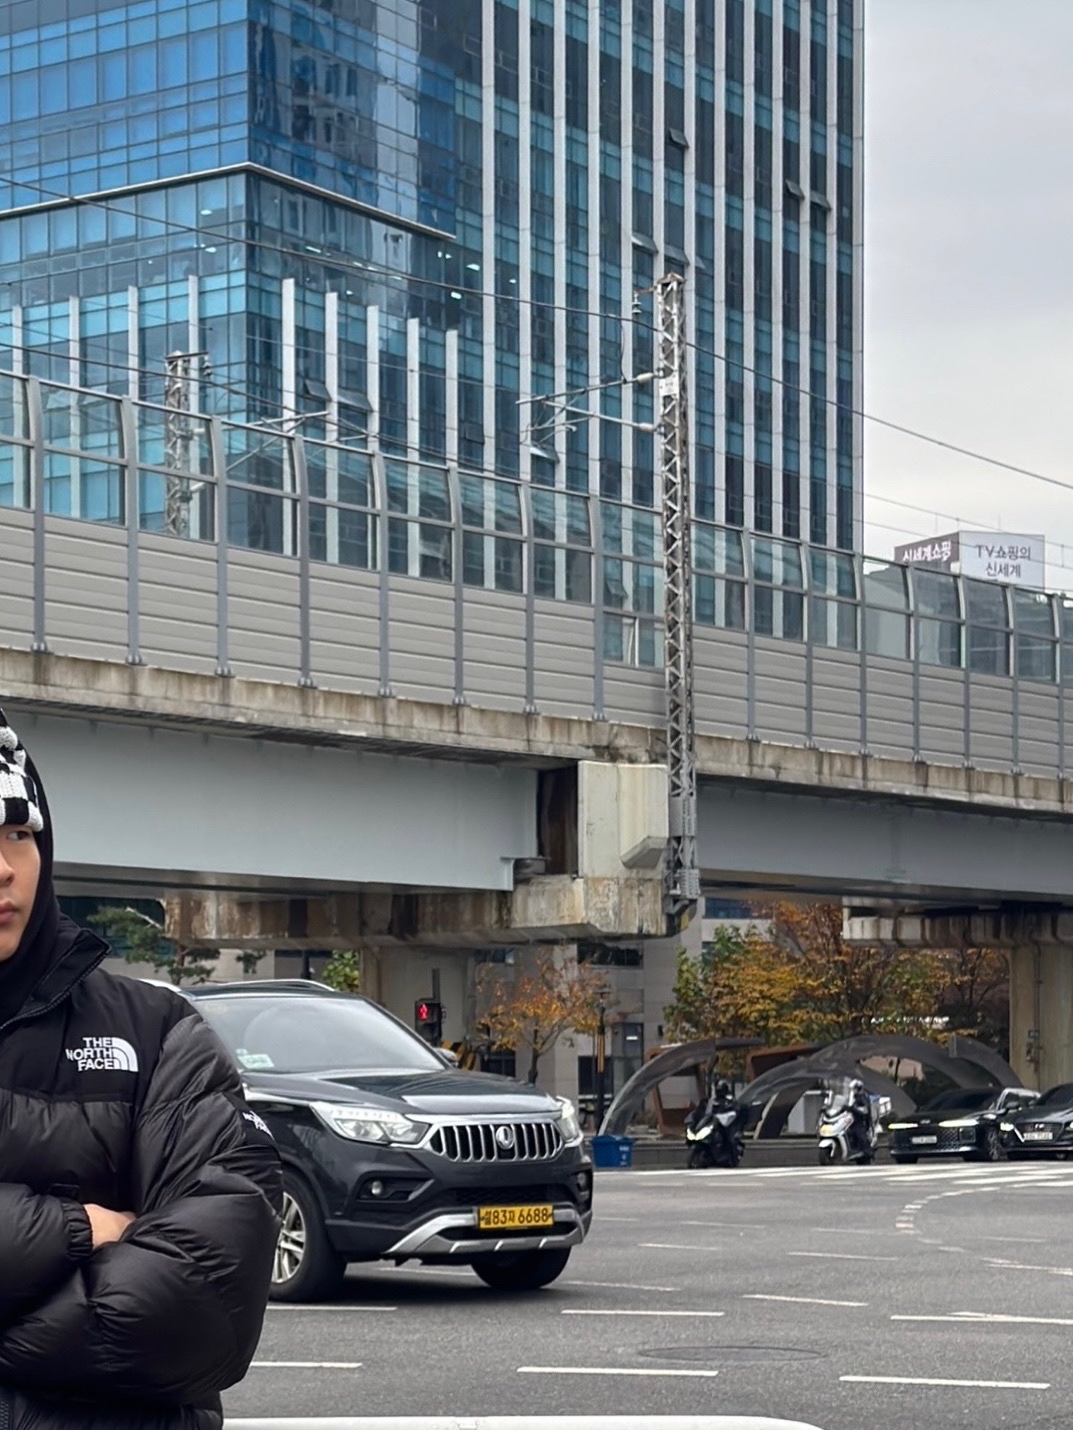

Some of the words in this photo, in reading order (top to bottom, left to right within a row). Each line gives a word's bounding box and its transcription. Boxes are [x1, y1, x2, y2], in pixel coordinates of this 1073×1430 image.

[977, 545, 1031, 560] TV쇼핑의
[986, 561, 1021, 578] 신세계
[82, 1036, 112, 1048] THE
[65, 1047, 112, 1061] NORTH
[78, 1058, 114, 1071] FACE
[518, 1207, 548, 1224] 6688
